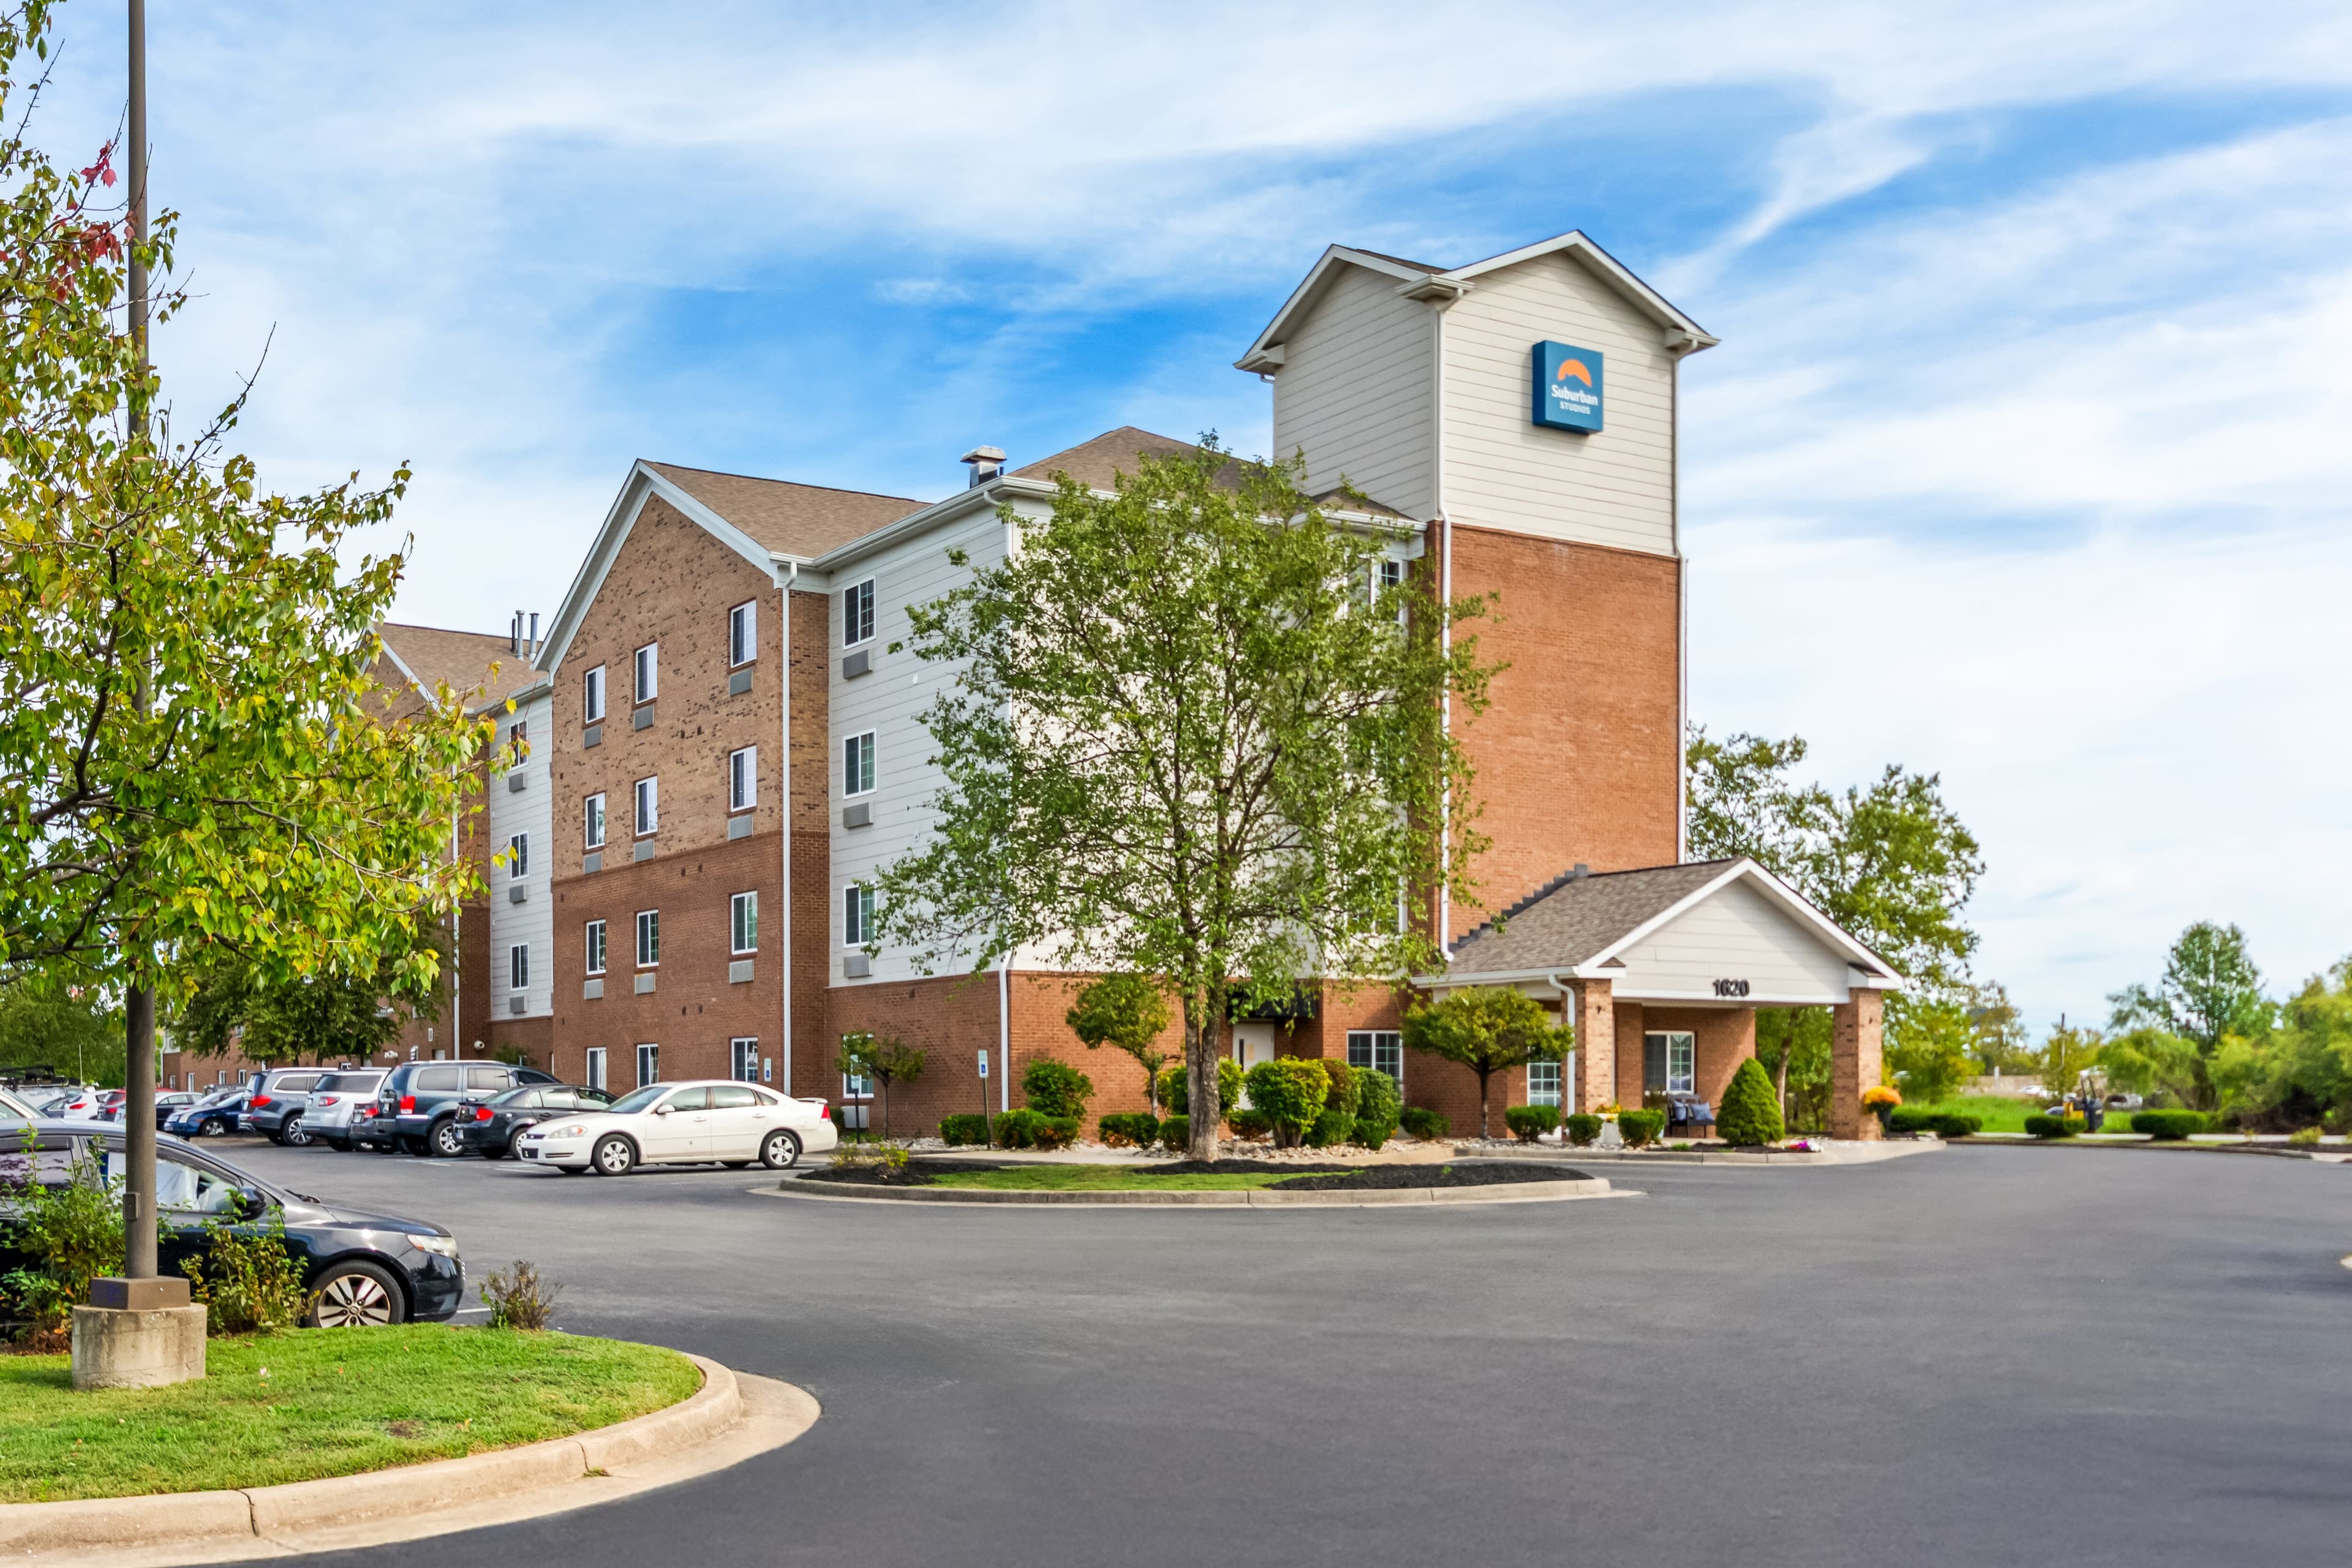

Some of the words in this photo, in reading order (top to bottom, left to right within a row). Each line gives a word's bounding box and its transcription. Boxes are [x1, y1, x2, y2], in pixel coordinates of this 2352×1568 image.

[1551, 385, 1598, 405] Suburban
[1559, 401, 1591, 415] STUDIOS
[1713, 979, 1749, 997] 1620
